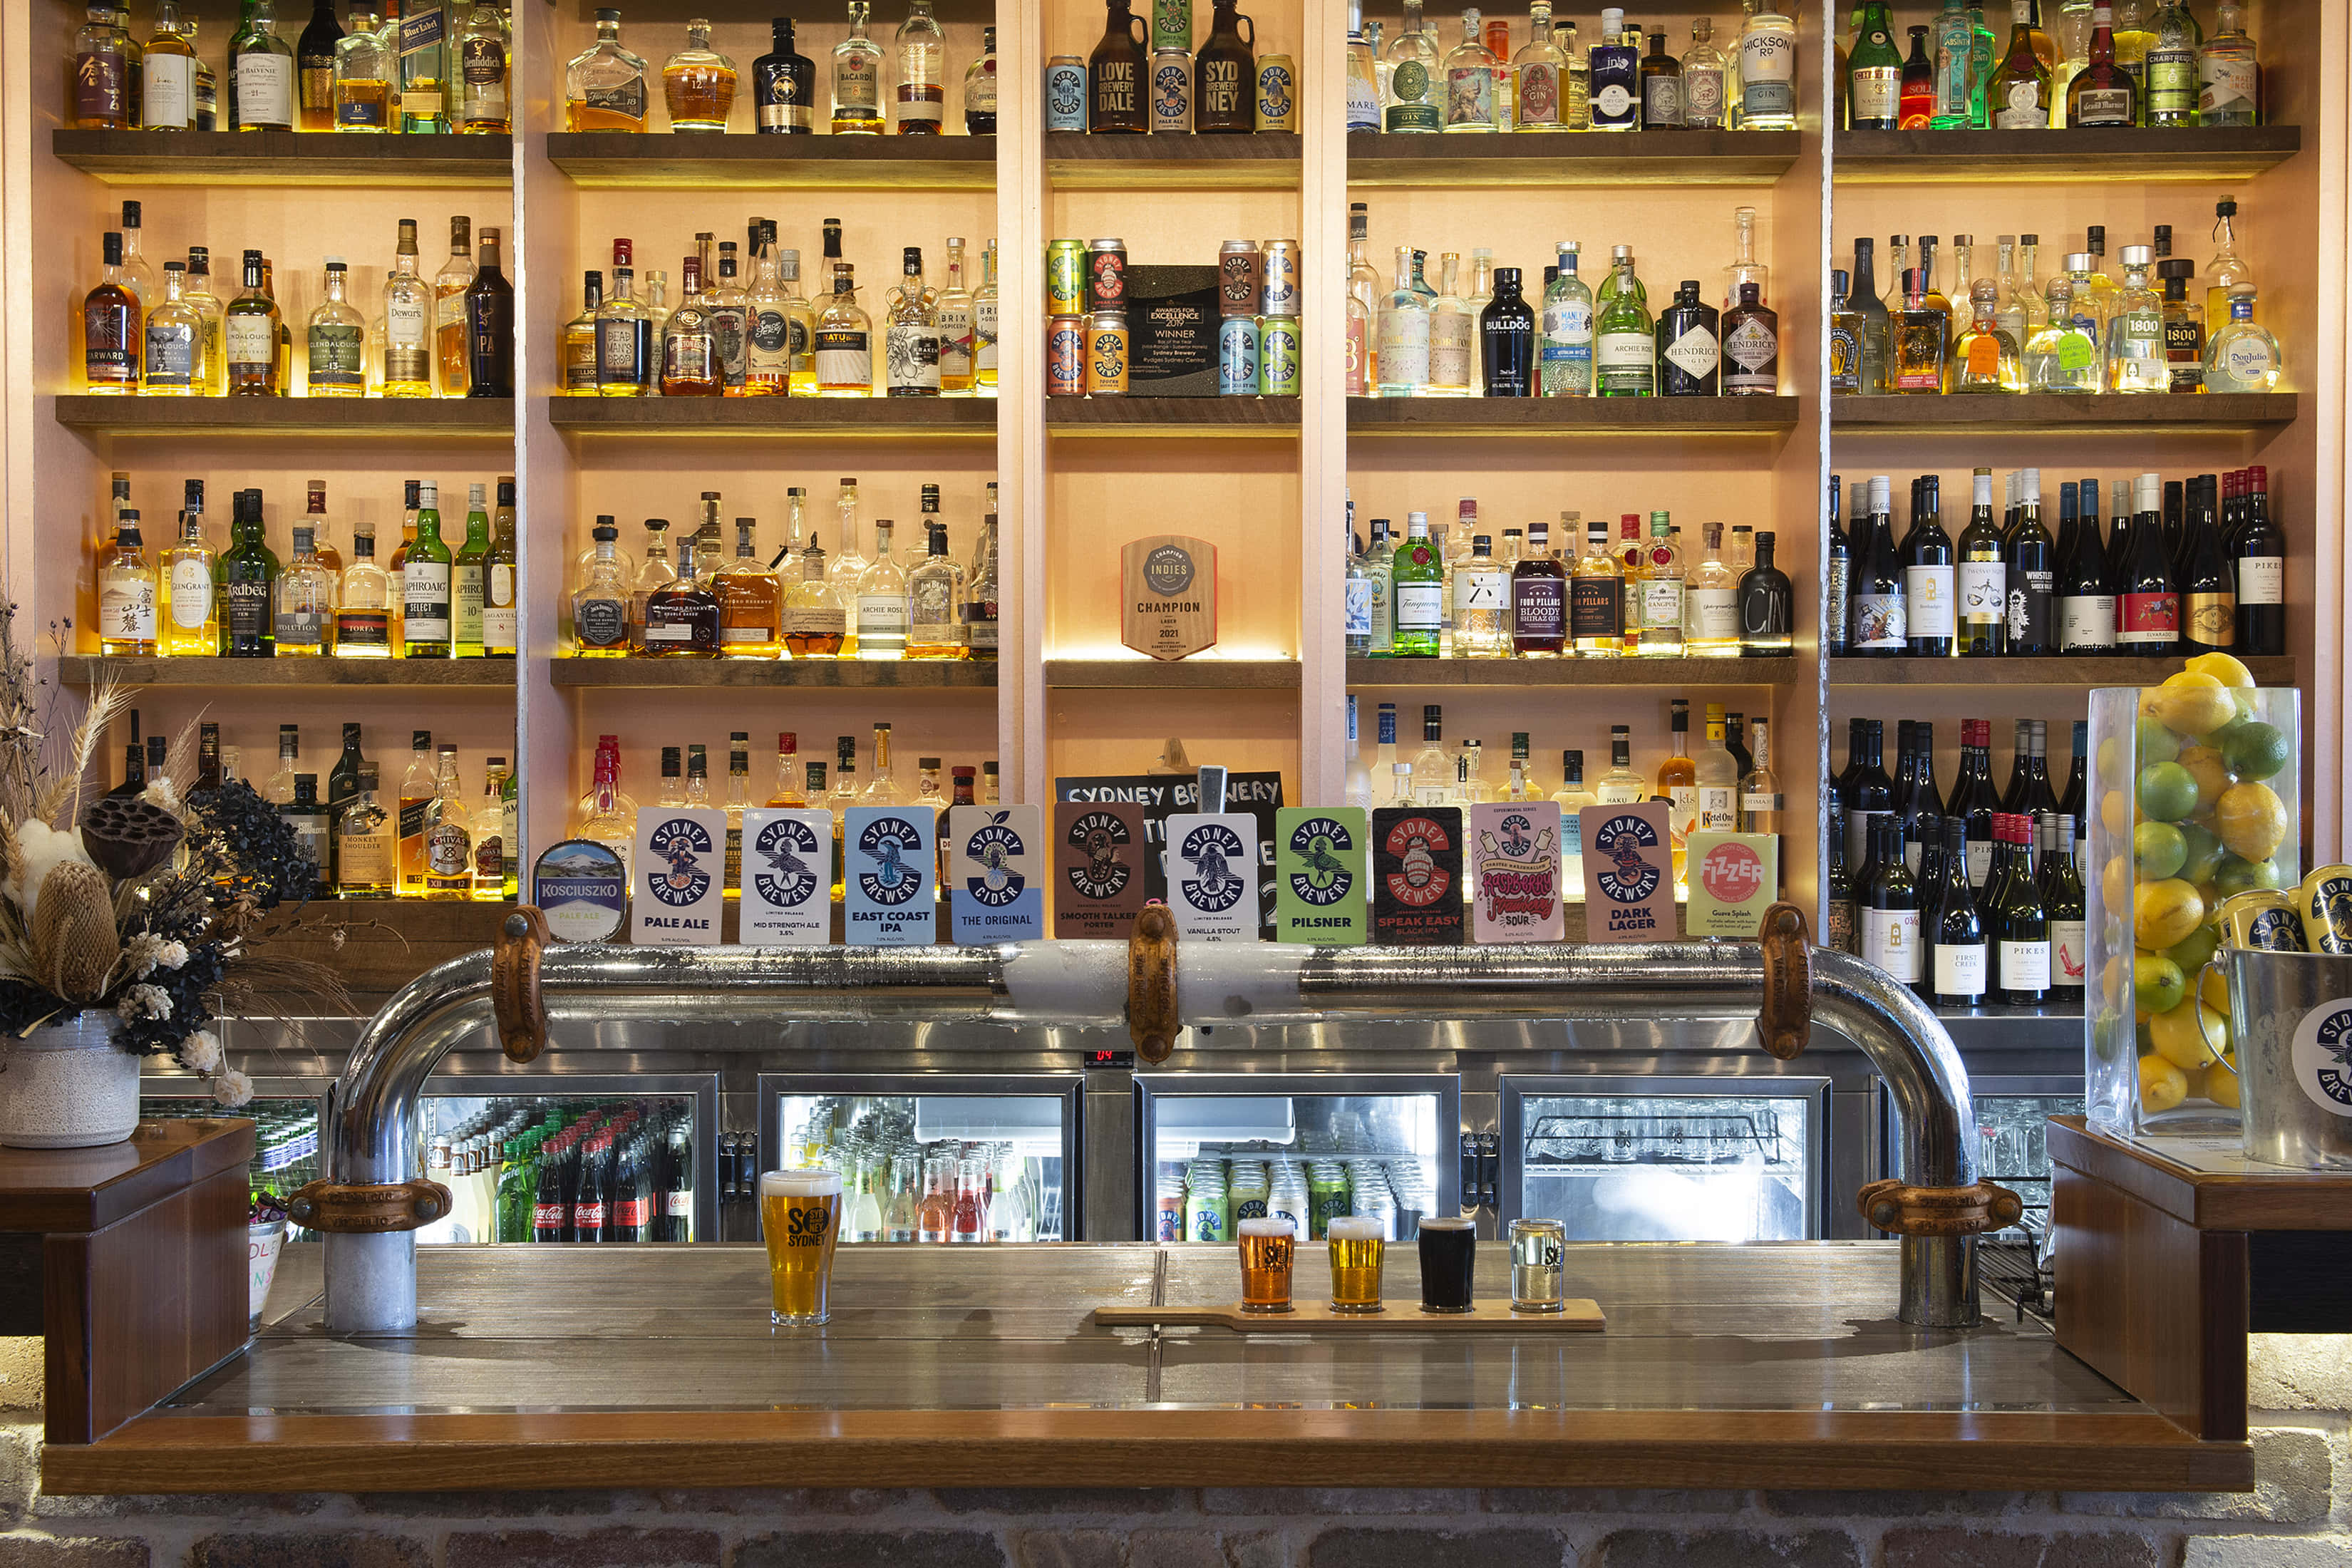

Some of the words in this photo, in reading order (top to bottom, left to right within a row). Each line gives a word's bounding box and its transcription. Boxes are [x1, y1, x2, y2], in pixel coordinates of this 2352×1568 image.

[403, 26, 420, 38] Blue
[420, 19, 438, 33] Label
[1160, 18, 1187, 33] BREWERY
[1744, 36, 1790, 53] HICKSON
[463, 56, 500, 68] Glenfiddich
[840, 73, 872, 82] BACARDÍ
[1098, 62, 1134, 81] LOVE
[1157, 67, 1186, 83] SYDNEY
[1206, 61, 1239, 81] SYD
[1261, 67, 1290, 84] SYDNEY
[852, 84, 860, 96] 8
[1098, 81, 1134, 93] BREWERY
[1206, 82, 1239, 92] BREWERY
[1206, 93, 1239, 111] NEY
[1530, 91, 1546, 100] GIN
[1053, 100, 1080, 113] BREWERY
[1098, 93, 1135, 112] DALE
[1156, 100, 1187, 115] BREWERY
[1260, 100, 1290, 116] BREWERY
[1095, 254, 1122, 268] SYDNEY
[1224, 257, 1250, 271] SYDNEY
[1095, 283, 1123, 298] BREWERY
[1224, 286, 1252, 300] BREWERY
[391, 308, 422, 319] Dewar's
[1562, 311, 1582, 320] MANLY
[1486, 321, 1530, 330] BULLDOG
[1562, 323, 1582, 331] SPIRITS
[2129, 320, 2158, 332] 1800
[607, 330, 631, 342] DEAD
[823, 333, 846, 341] RATU
[1155, 330, 1195, 339] WINNER
[2167, 329, 2196, 341] 1800
[309, 341, 361, 349] GLENDALOUGH
[477, 335, 495, 352] IPA
[1097, 335, 1121, 348] SYDNEY
[607, 343, 632, 354] MAN'S
[607, 354, 631, 366] DROP
[1096, 363, 1123, 377] BREWERY
[1155, 550, 1183, 559] CHAMPION
[1151, 564, 1187, 574] INDIES
[2026, 571, 2053, 579] WHISTLER
[405, 582, 446, 592] APHROAIG
[410, 603, 432, 612] SELECT
[467, 606, 477, 617] 10
[1138, 602, 1200, 613] CHAMPION
[498, 623, 505, 631] 8
[1160, 629, 1178, 638] 2021
[1068, 785, 1165, 807] SYDNEY
[1174, 781, 1278, 805] BRWERY
[1073, 815, 1126, 838] SYDNEY
[1502, 816, 1529, 829] SYDNEY
[655, 822, 708, 845] SYDNEY
[761, 822, 814, 845] SYDNEY
[864, 820, 917, 844] SYDNEY
[1295, 821, 1348, 845] SYDNEY
[1392, 822, 1445, 845] SYDNEY
[1600, 818, 1654, 843] SYDNEY
[433, 836, 467, 846] CHIVAS
[971, 828, 1021, 850] SYDNEY
[1186, 827, 1239, 851] SYDNEY
[1502, 841, 1531, 856] BREWERY
[1699, 856, 1766, 884] FIZZER
[862, 875, 919, 904] BREWERY
[1071, 869, 1128, 897] BREWERY
[1601, 872, 1656, 900] BREWERY
[541, 883, 618, 898] KOSCIUSZKO
[651, 876, 708, 904] BREWERY
[758, 877, 814, 904] BREWERY
[974, 885, 1018, 904] CIDER
[1185, 882, 1240, 909] BREWERY
[1294, 876, 1348, 904] BREWERY
[1391, 876, 1446, 904] BREWERY
[852, 912, 885, 921] EAST
[887, 912, 930, 921] COAST
[1611, 907, 1652, 919] DARK
[1732, 909, 1751, 918] Splash
[644, 917, 680, 928] PALE
[684, 918, 710, 929] ALE
[961, 916, 981, 926] THE
[985, 914, 1033, 926] ORIGINAL
[1291, 917, 1352, 928] PILSNER
[1378, 917, 1424, 927] SPEAK
[1426, 916, 1460, 926] EASY
[1506, 915, 1530, 926] SOUR
[1609, 919, 1656, 931] LAGER
[880, 923, 902, 932] IPA
[2013, 947, 2046, 955] PIKES
[1321, 1200, 1346, 1212] SYDNEY
[788, 1234, 827, 1248] SYDNEY
